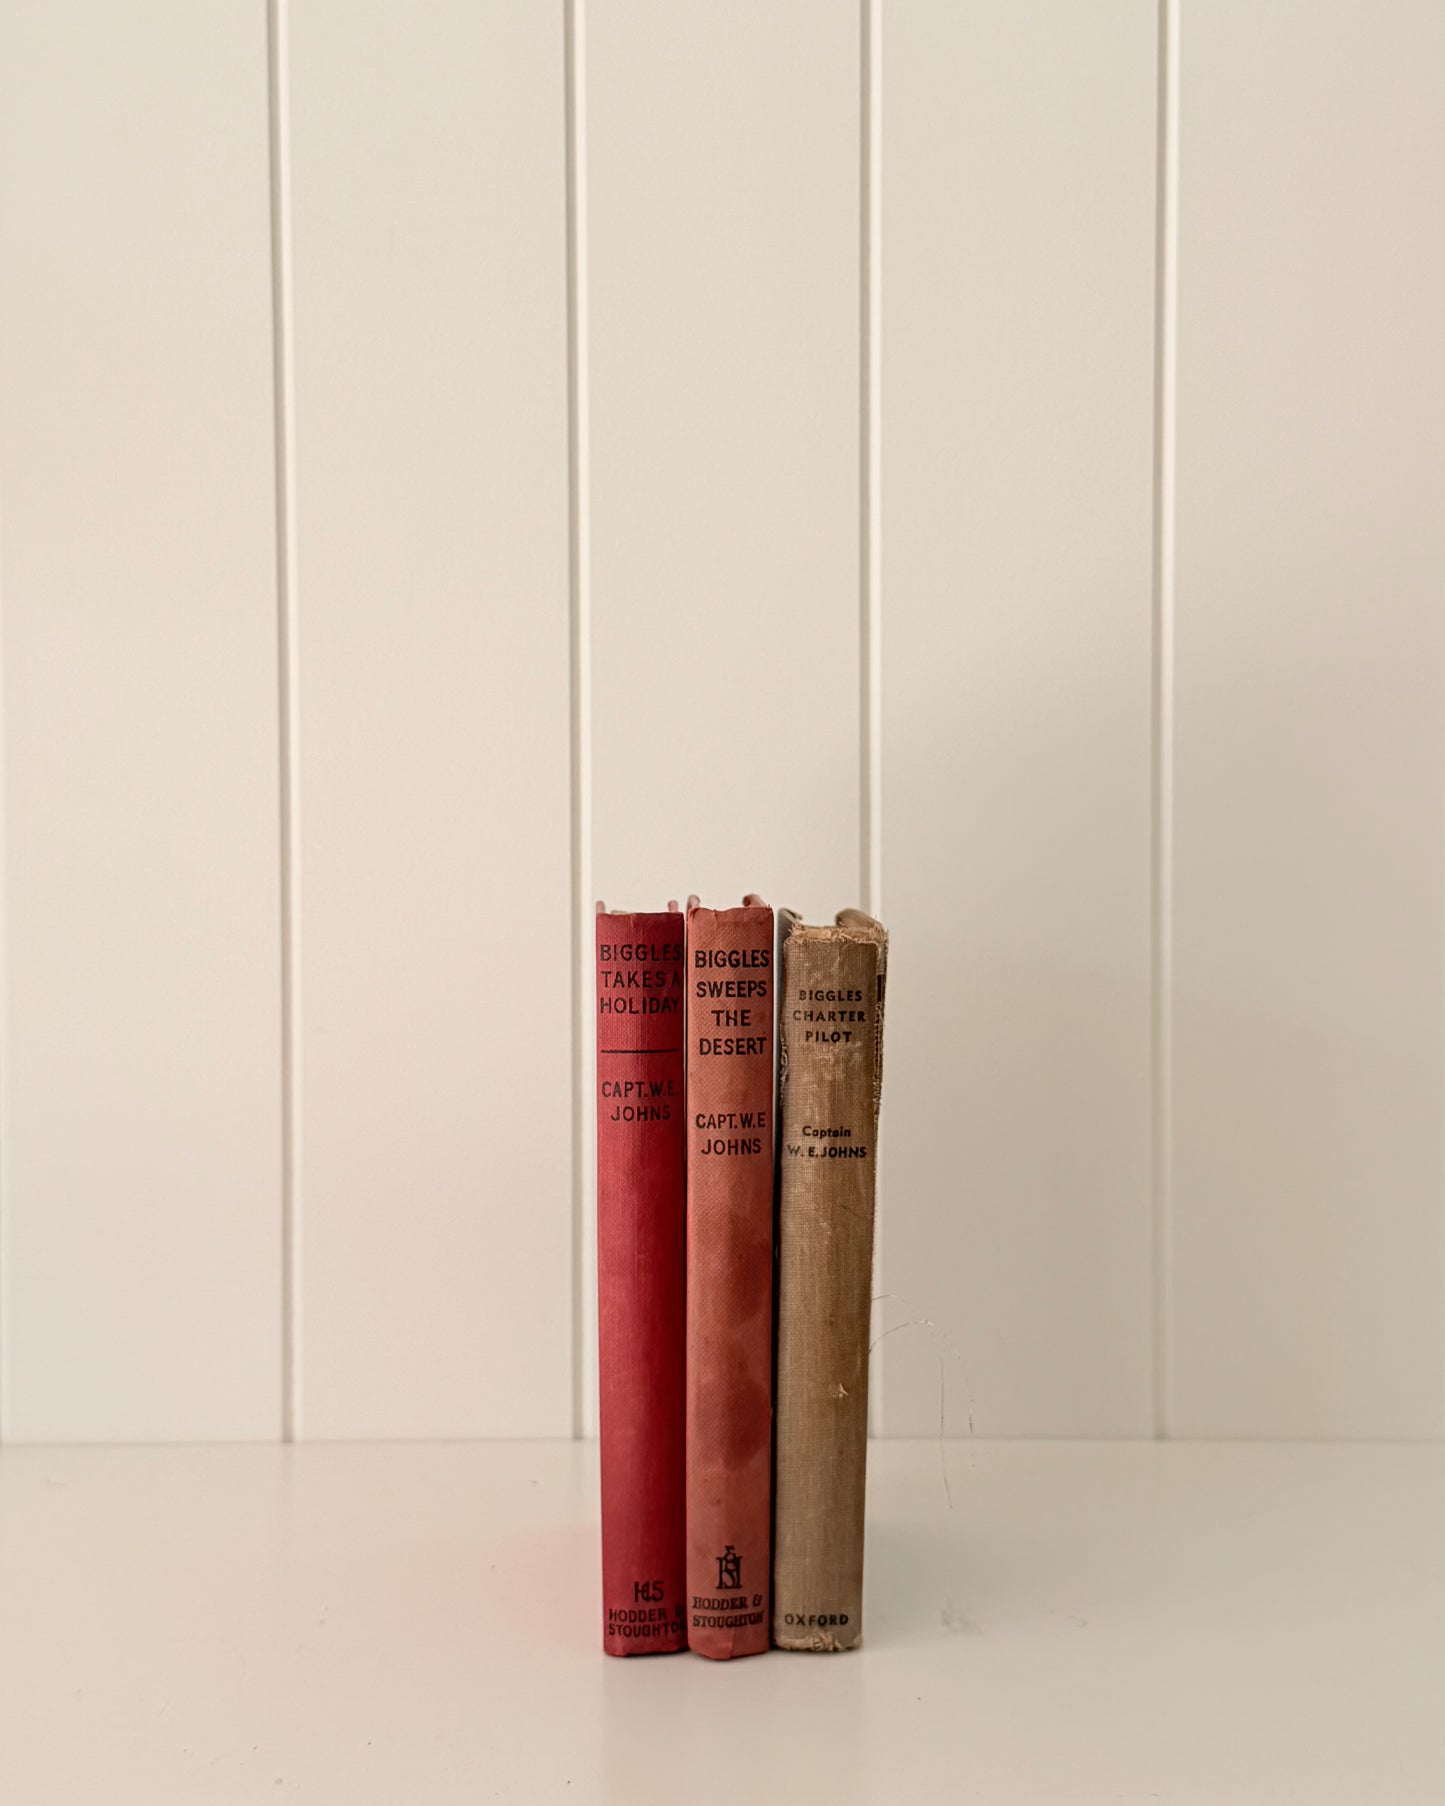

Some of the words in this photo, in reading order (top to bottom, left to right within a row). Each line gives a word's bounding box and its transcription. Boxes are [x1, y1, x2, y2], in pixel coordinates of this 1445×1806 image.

[600, 944, 681, 962] BIGGLES
[695, 950, 770, 968] BIGGLES
[601, 970, 666, 988] TAKES
[671, 970, 681, 987] A
[696, 980, 768, 998] SWEEPS
[799, 990, 863, 1002] BIGGLES
[600, 997, 680, 1014] HOLIDAY
[711, 1009, 752, 1027] THE
[793, 1010, 866, 1022] CHARTER
[805, 1031, 853, 1043] PILOT
[699, 1037, 768, 1056] DESERT
[611, 1105, 671, 1121] JOHNS
[802, 1125, 851, 1139] Captain
[701, 1138, 762, 1155] JOHNS
[692, 1596, 749, 1611] HODDER
[608, 1607, 667, 1623] HODDER
[692, 1610, 765, 1628] STOUGHTON
[784, 1613, 849, 1626] OXFORD
